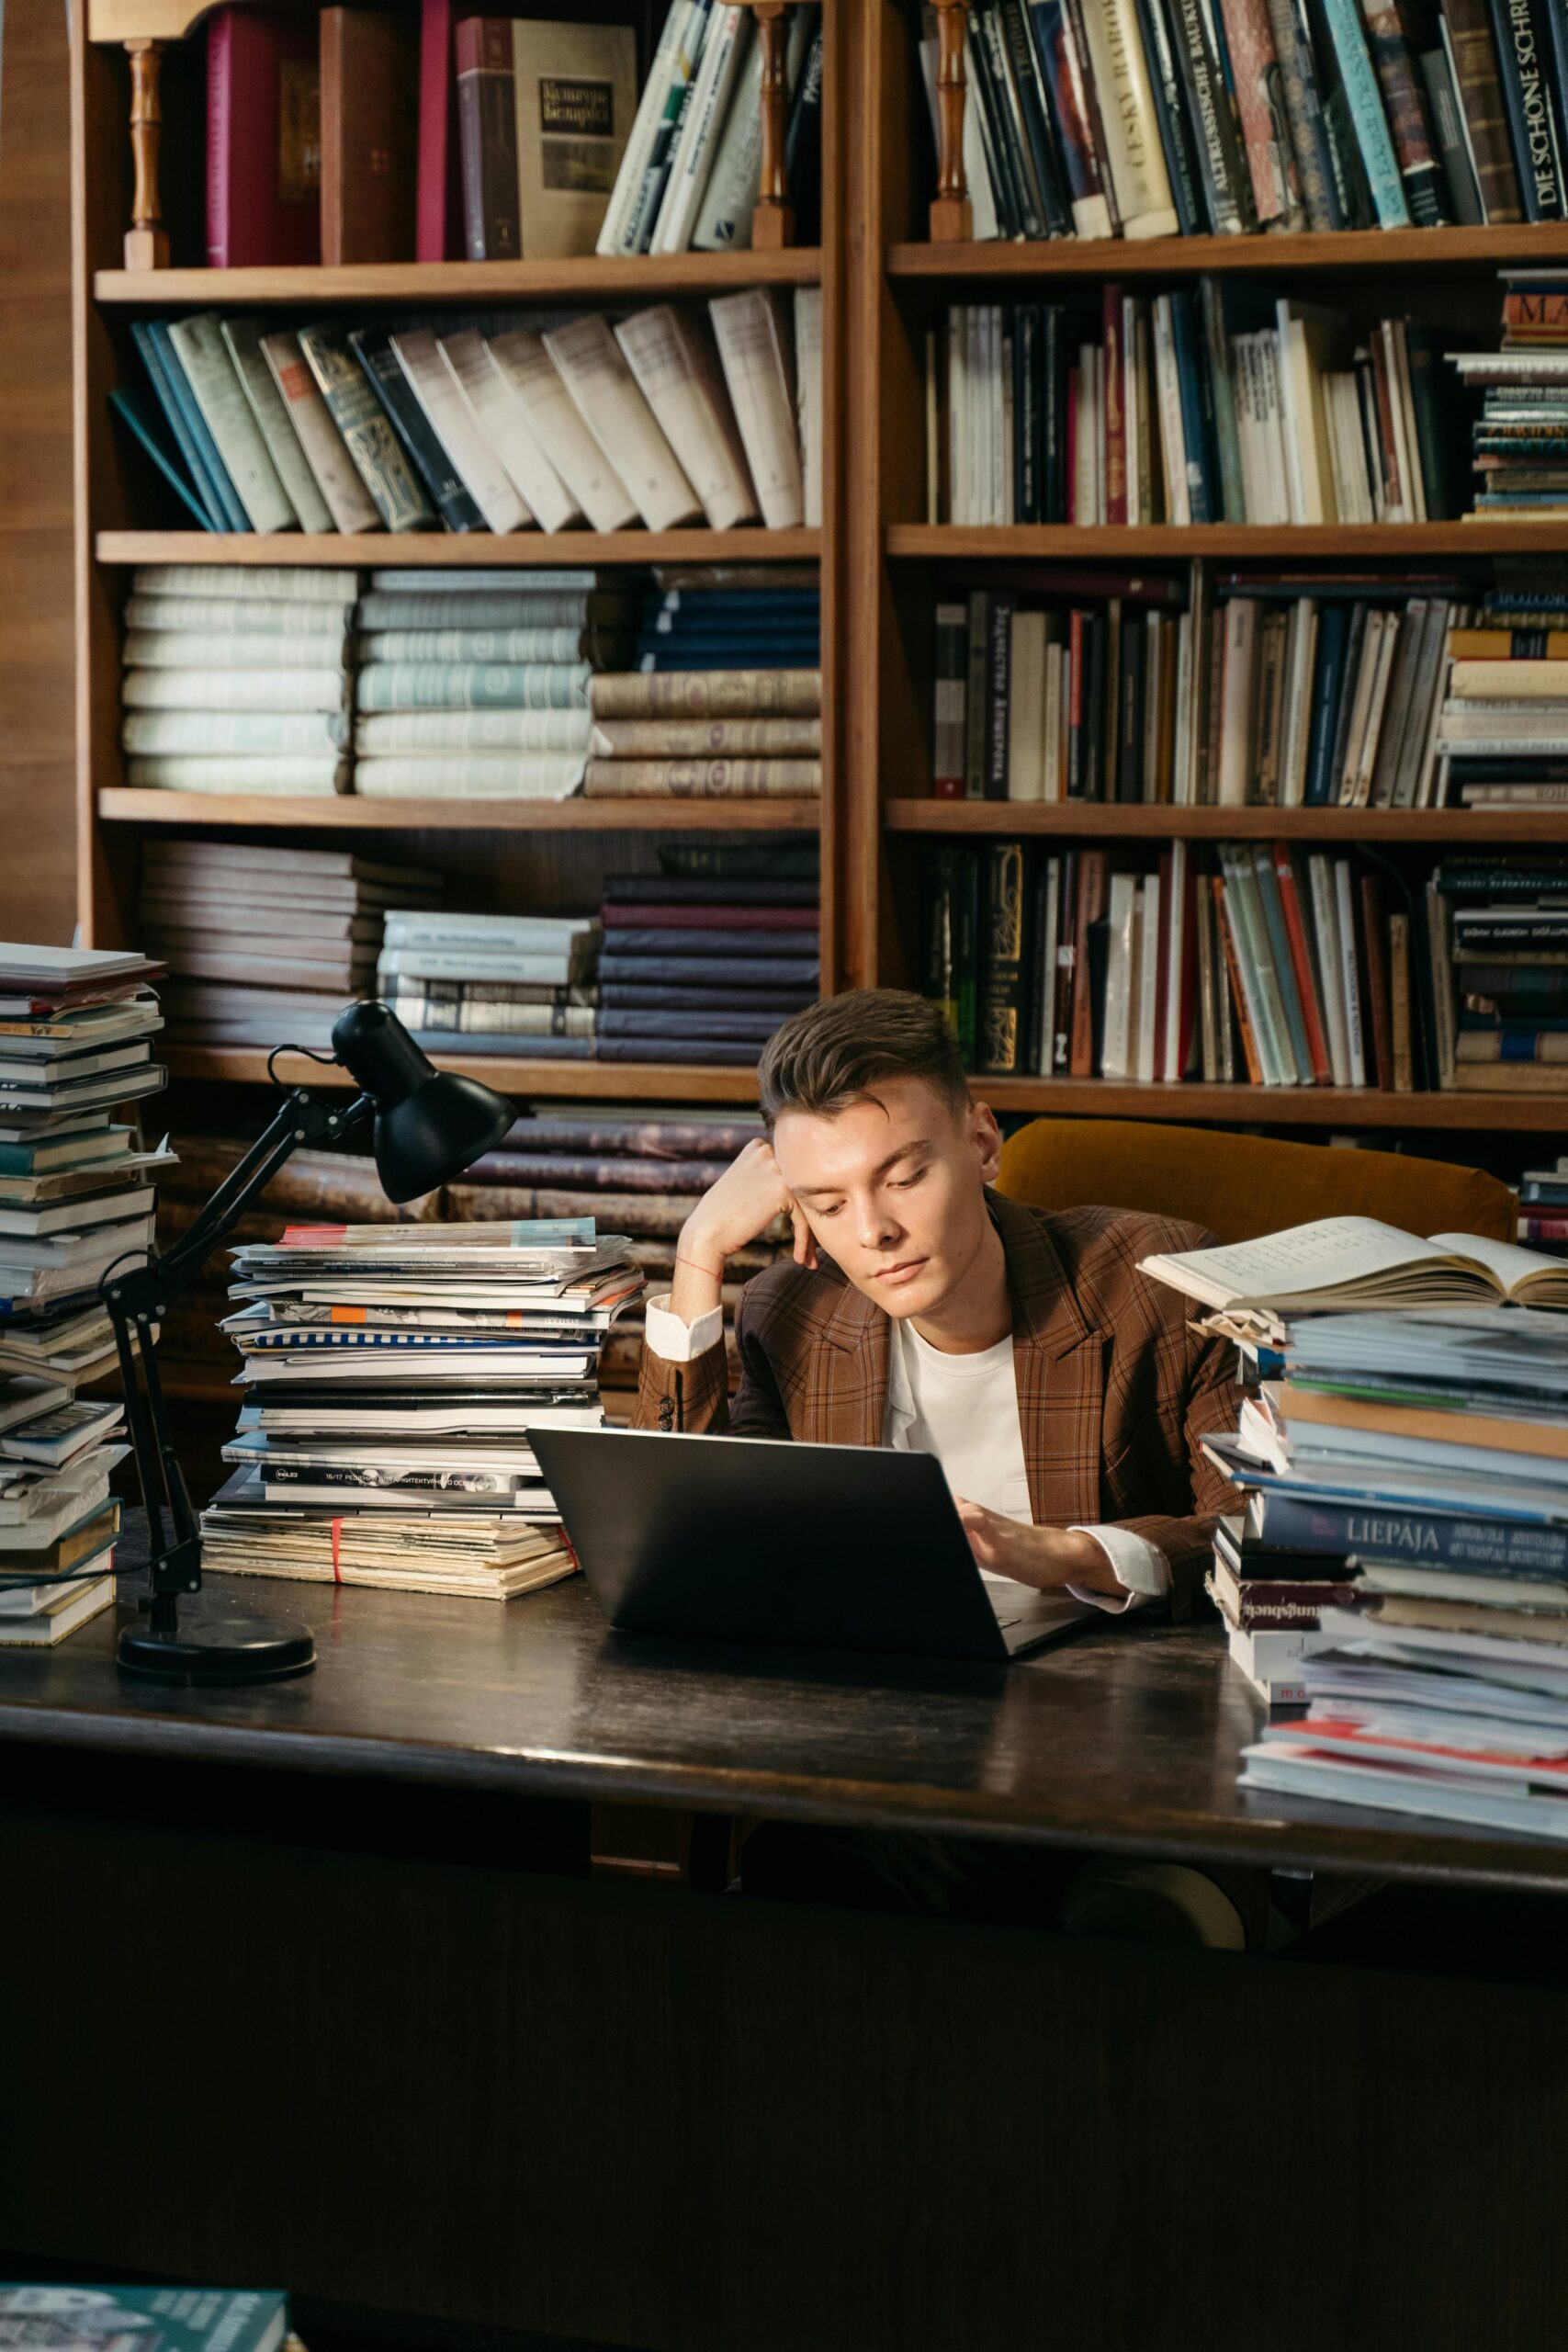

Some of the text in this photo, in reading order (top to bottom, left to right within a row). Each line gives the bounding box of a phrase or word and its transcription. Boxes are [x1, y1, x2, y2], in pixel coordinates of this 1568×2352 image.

[1519, 69, 1552, 165] SCHÖNE
[1535, 169, 1559, 207] DIE
[1348, 1518, 1439, 1553] LIEPĀJA
